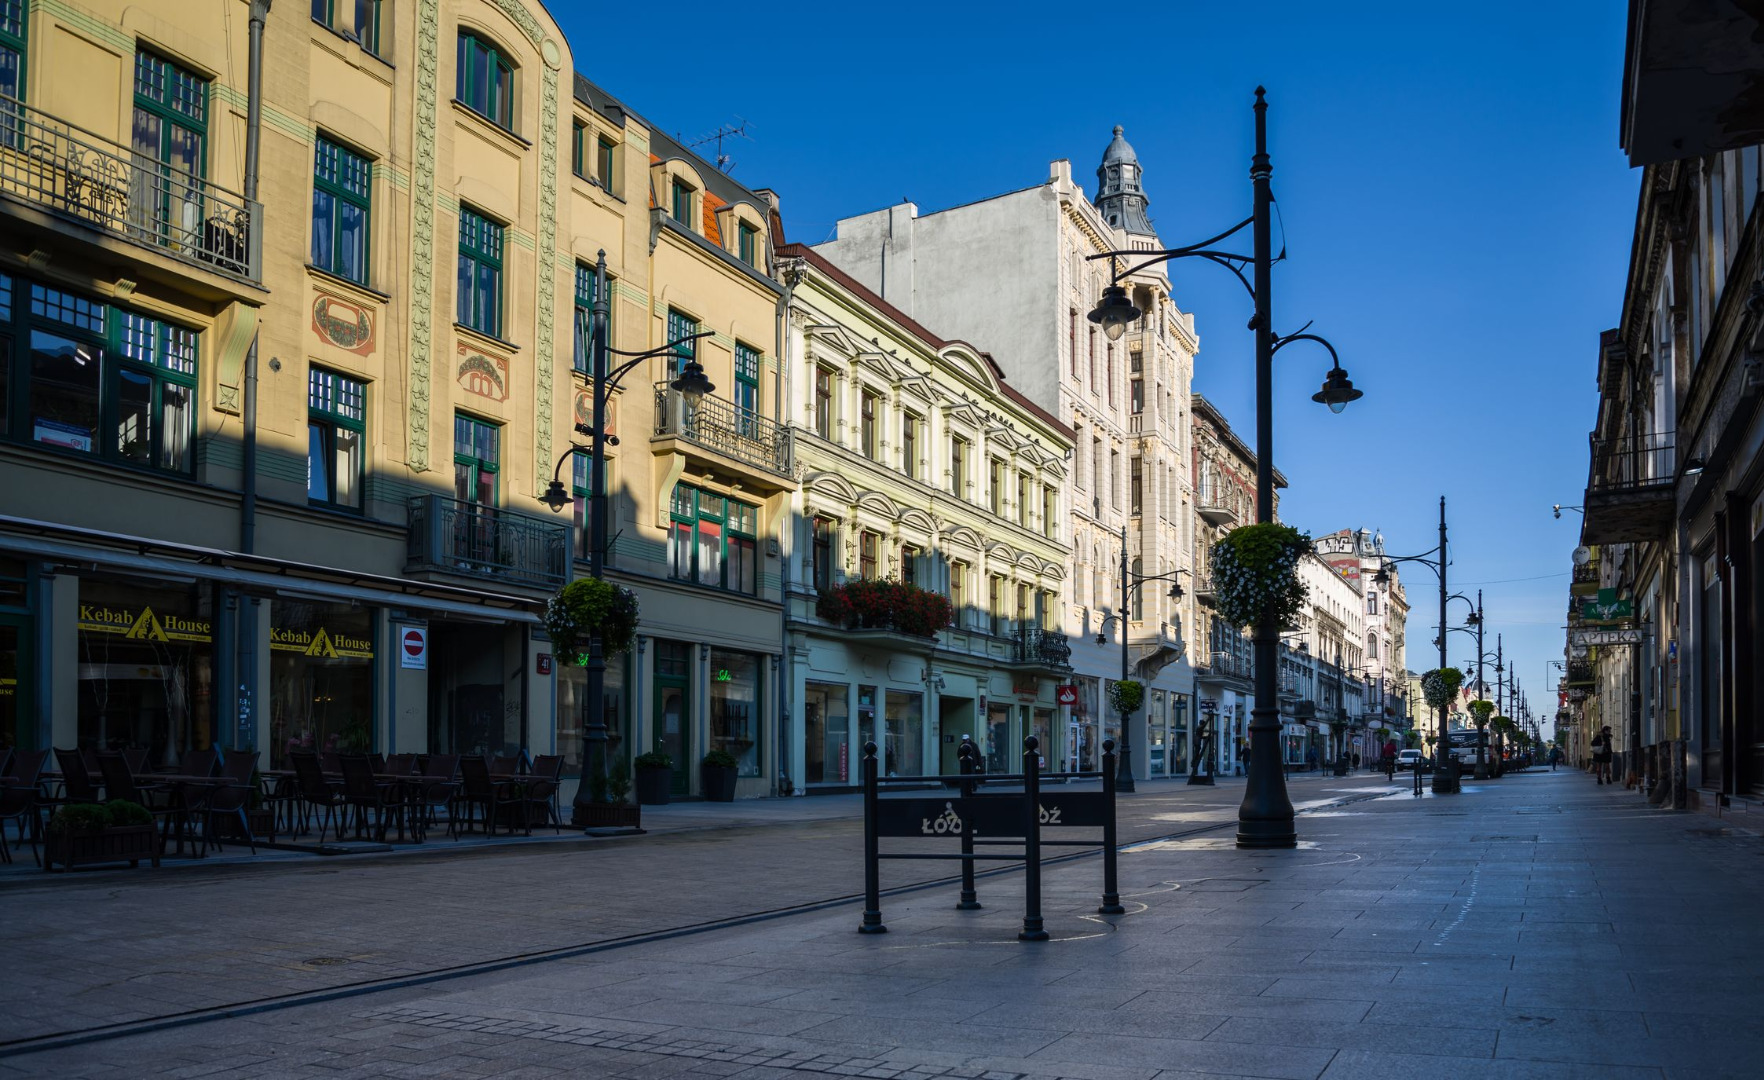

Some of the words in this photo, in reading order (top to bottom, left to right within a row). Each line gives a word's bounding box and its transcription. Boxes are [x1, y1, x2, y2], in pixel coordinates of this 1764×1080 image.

[80, 605, 134, 625] Kebab
[165, 615, 211, 633] House
[270, 627, 311, 644] Kebab
[335, 634, 371, 650] House
[1576, 631, 1641, 644] APTEKA
